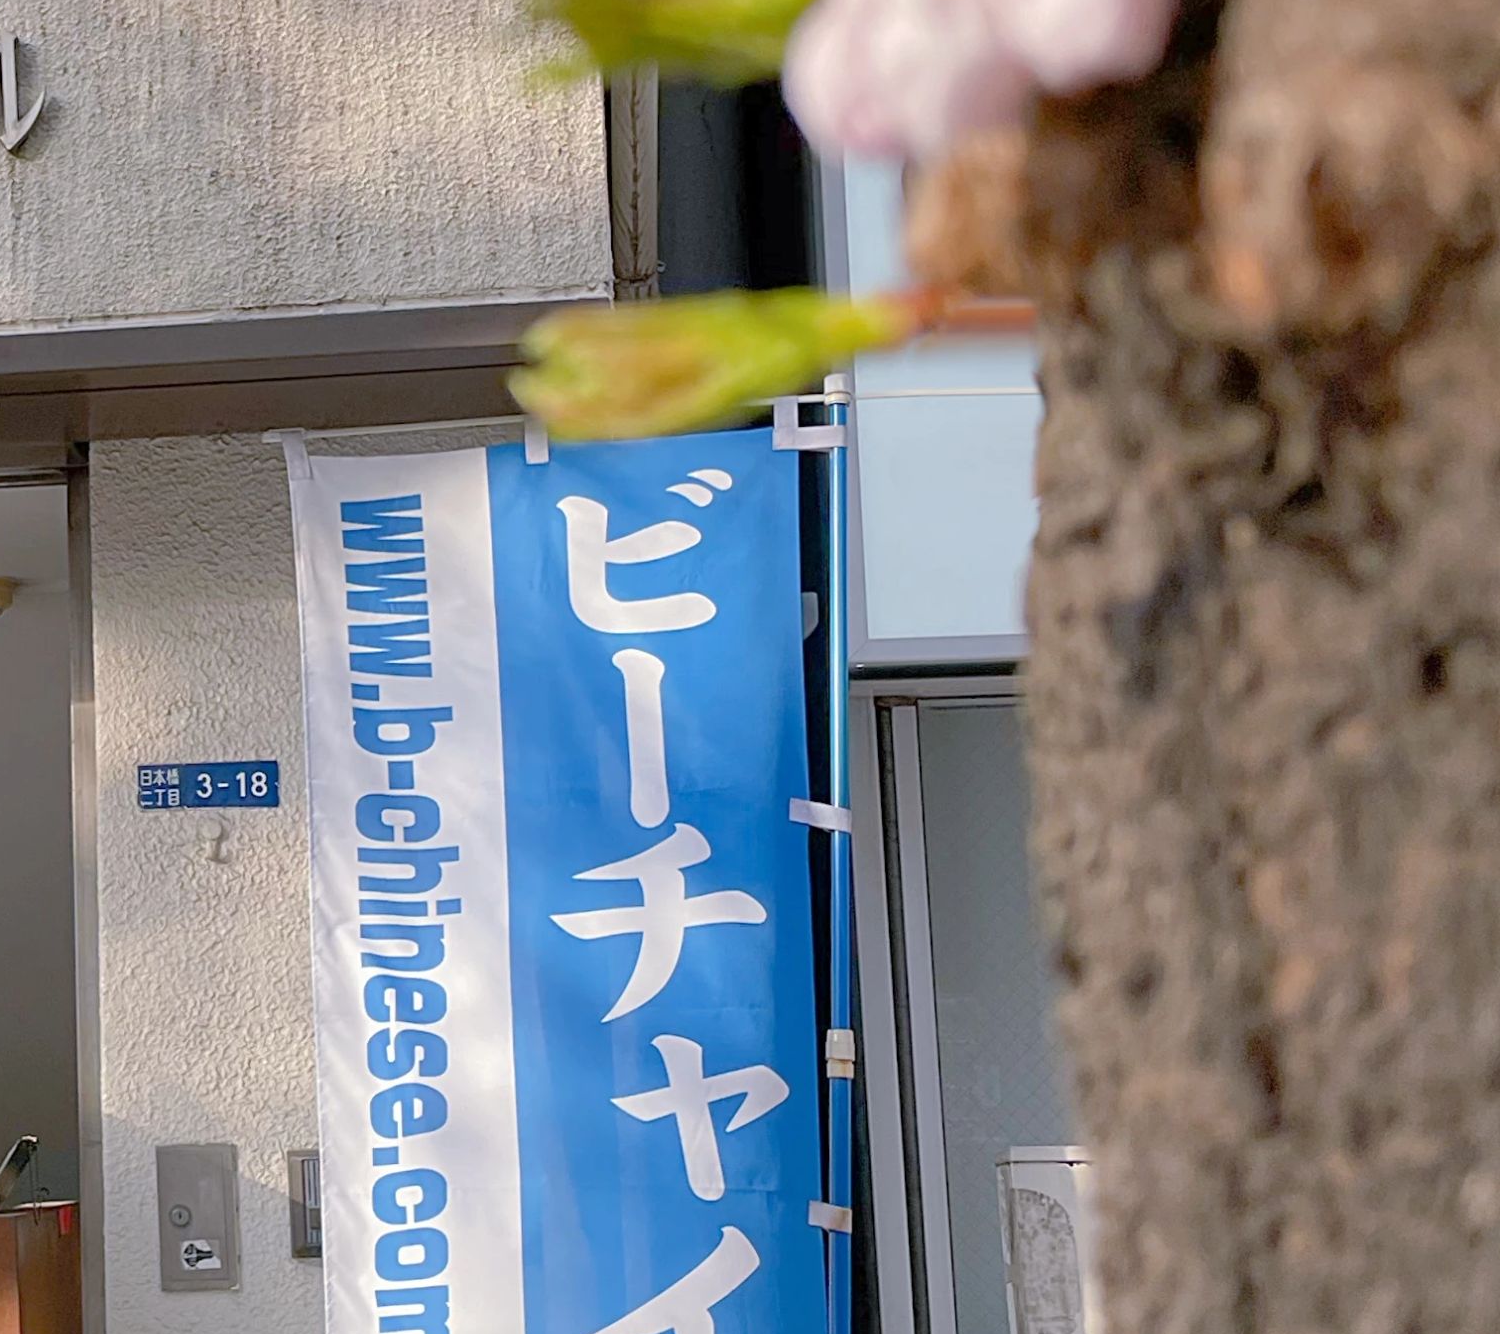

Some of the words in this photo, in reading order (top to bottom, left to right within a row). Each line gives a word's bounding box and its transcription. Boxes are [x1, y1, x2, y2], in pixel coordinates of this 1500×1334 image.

[140, 768, 180, 786] 日本橋
[196, 772, 268, 799] 3-18
